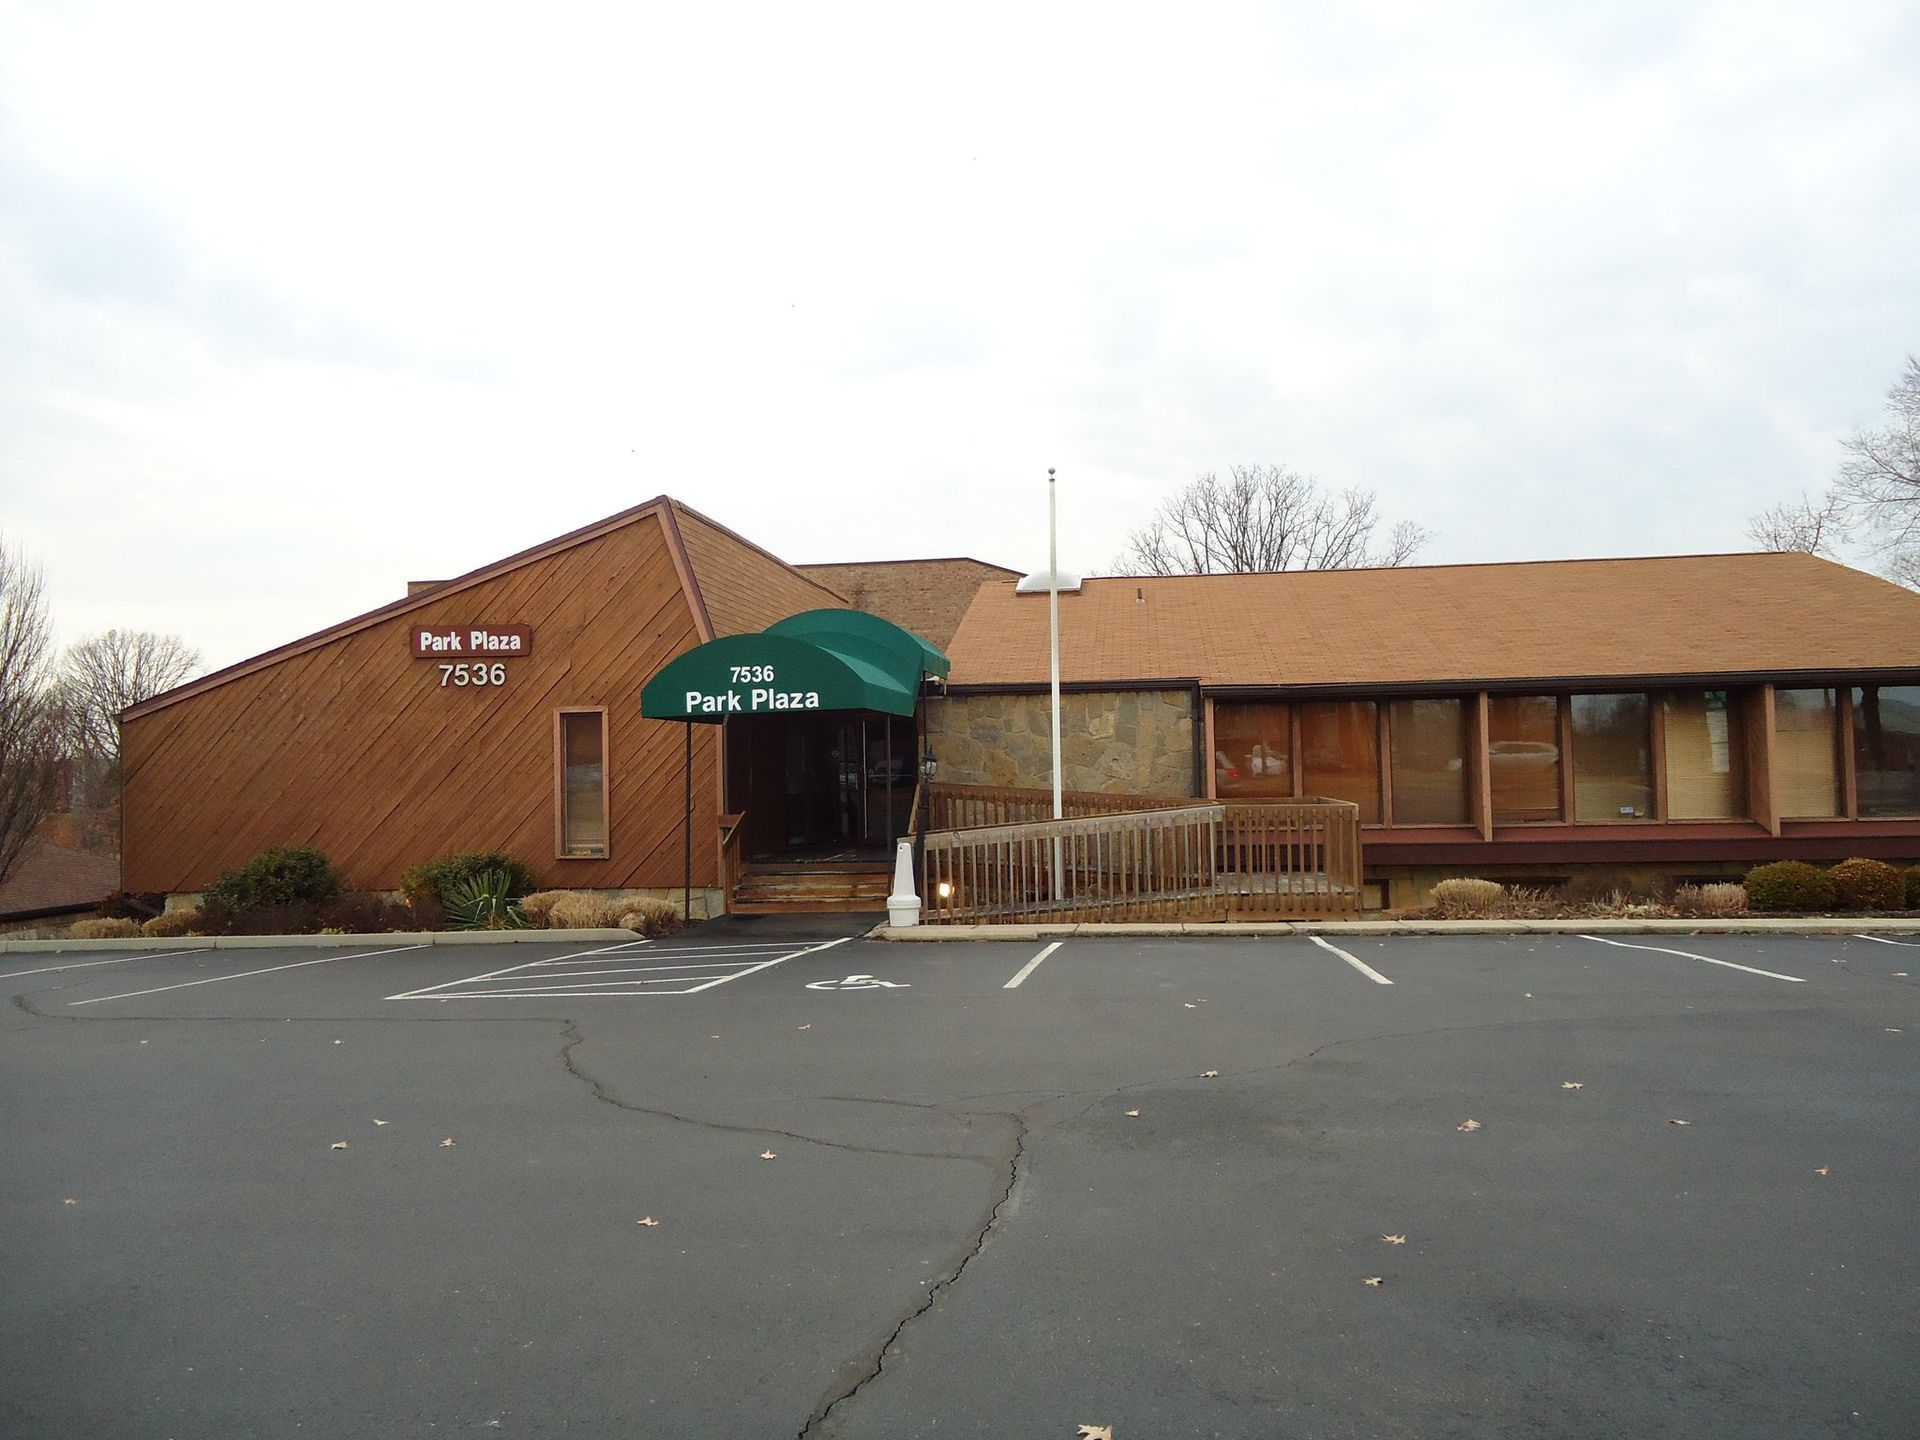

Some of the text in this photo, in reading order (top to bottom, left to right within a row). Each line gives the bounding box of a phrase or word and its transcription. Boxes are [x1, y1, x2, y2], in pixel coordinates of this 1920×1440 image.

[420, 631, 521, 651] Park Plaza
[438, 663, 506, 686] 7536
[730, 665, 775, 683] 7536
[686, 689, 820, 713] Park Plaza
